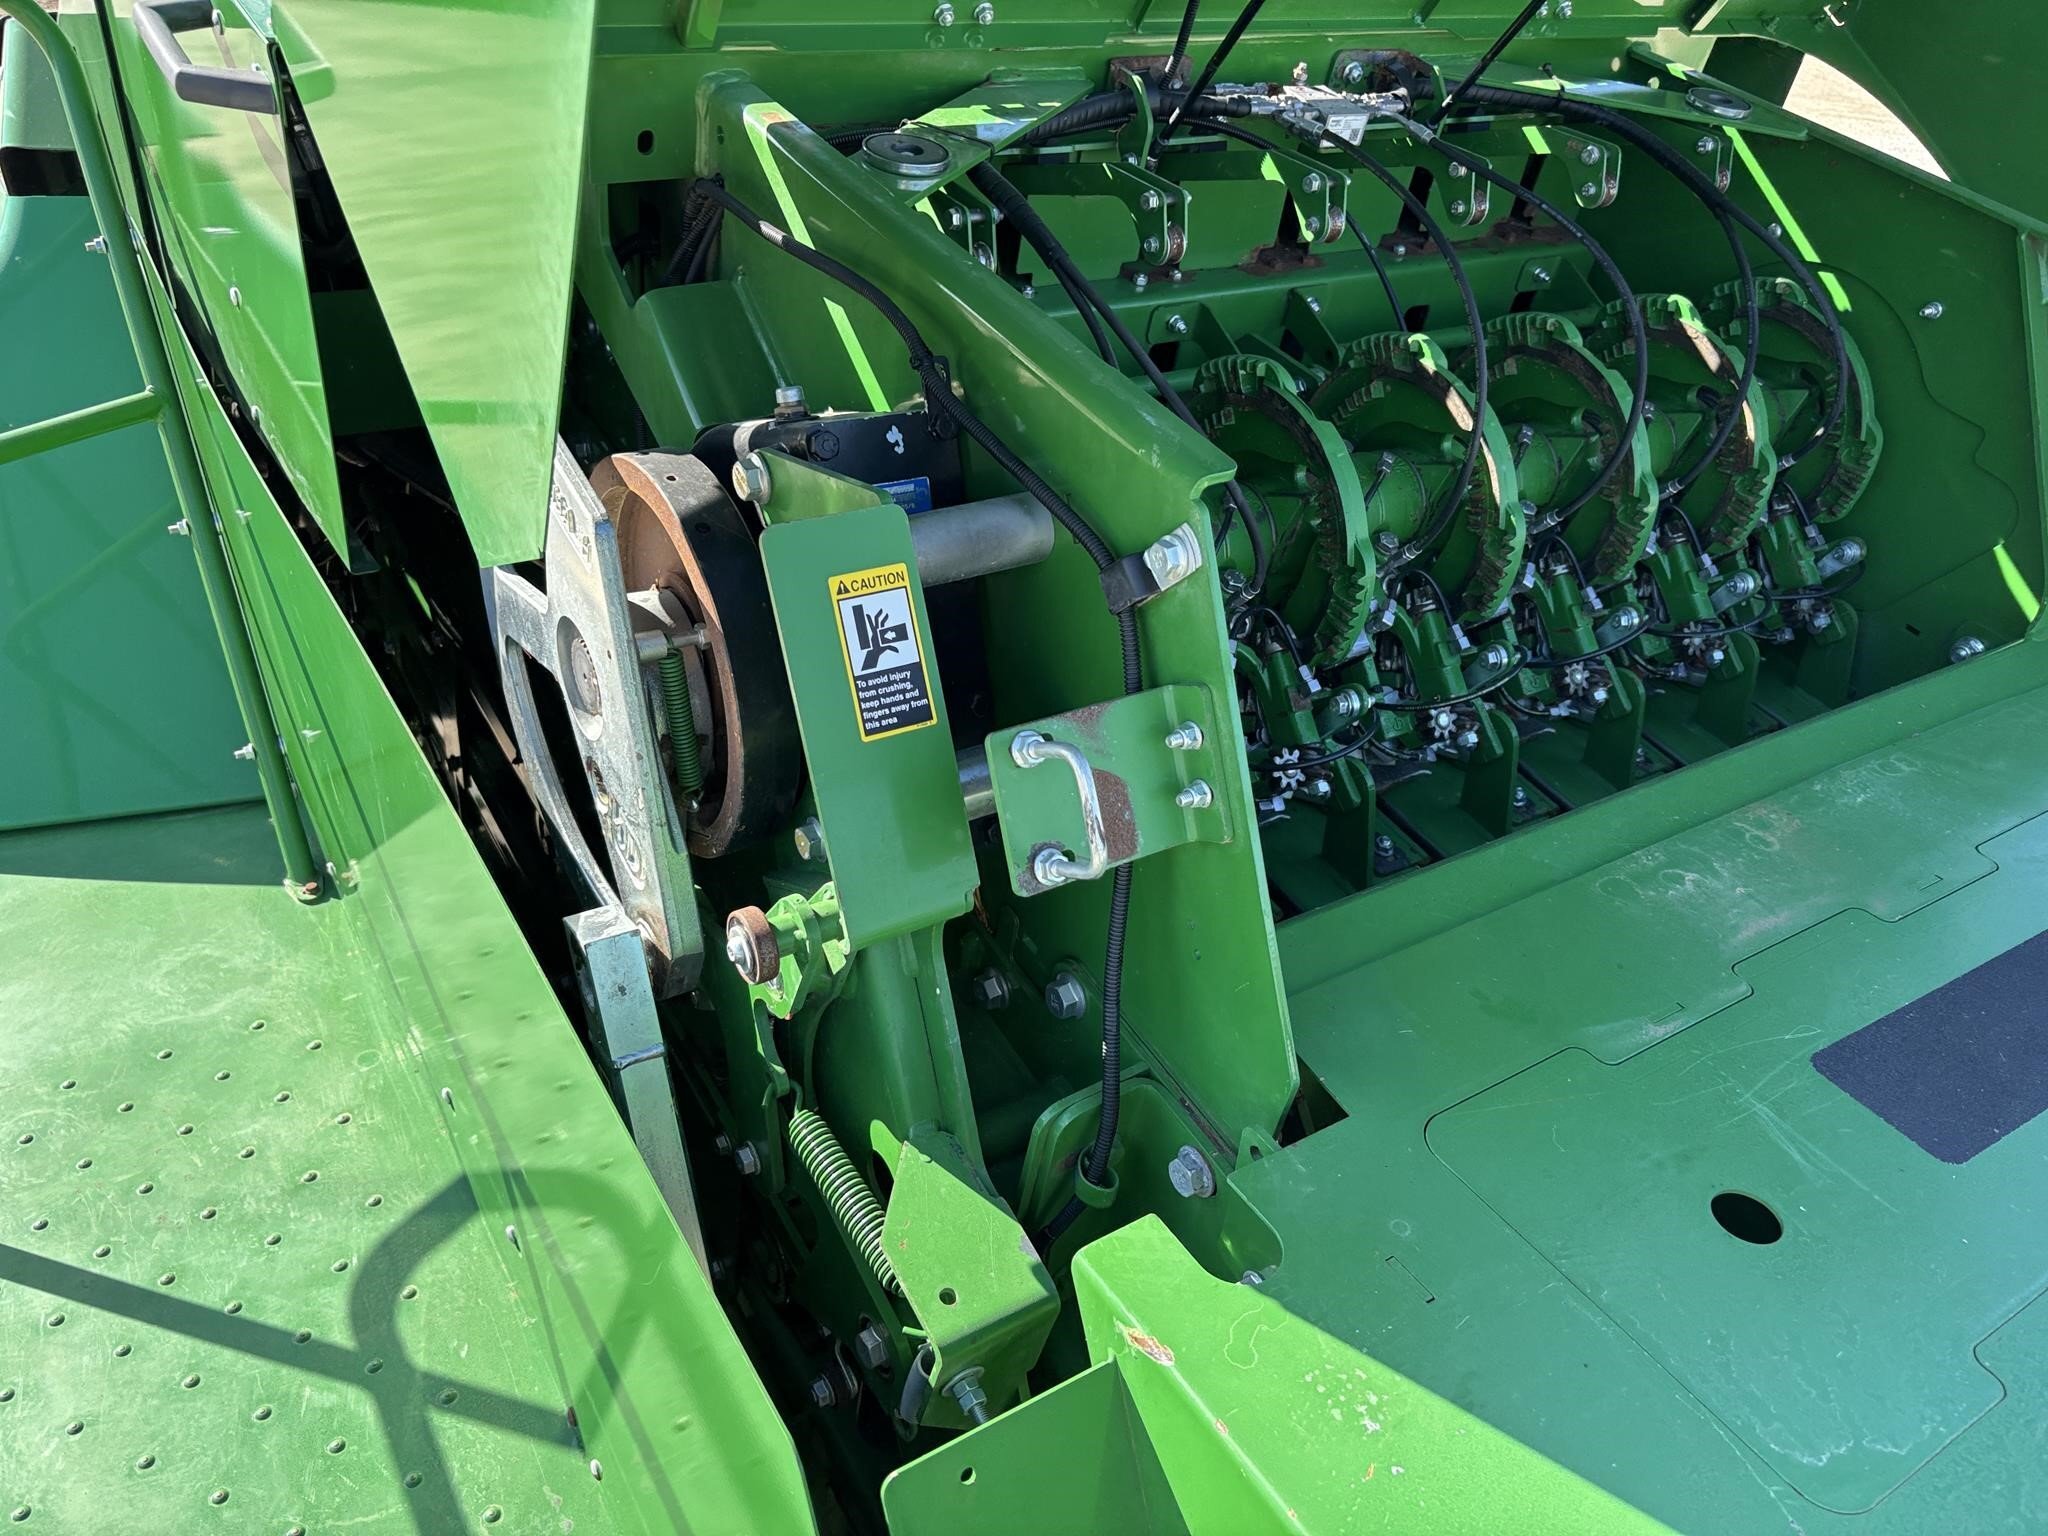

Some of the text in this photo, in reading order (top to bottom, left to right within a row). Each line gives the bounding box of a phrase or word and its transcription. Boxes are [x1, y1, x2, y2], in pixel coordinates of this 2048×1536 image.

[850, 570, 905, 592] CAUTION
[856, 670, 911, 689] To avoid injury
[858, 689, 877, 699] from
[861, 688, 920, 709] keep hands and
[863, 698, 928, 720] fingers away from
[865, 716, 898, 730] this area
